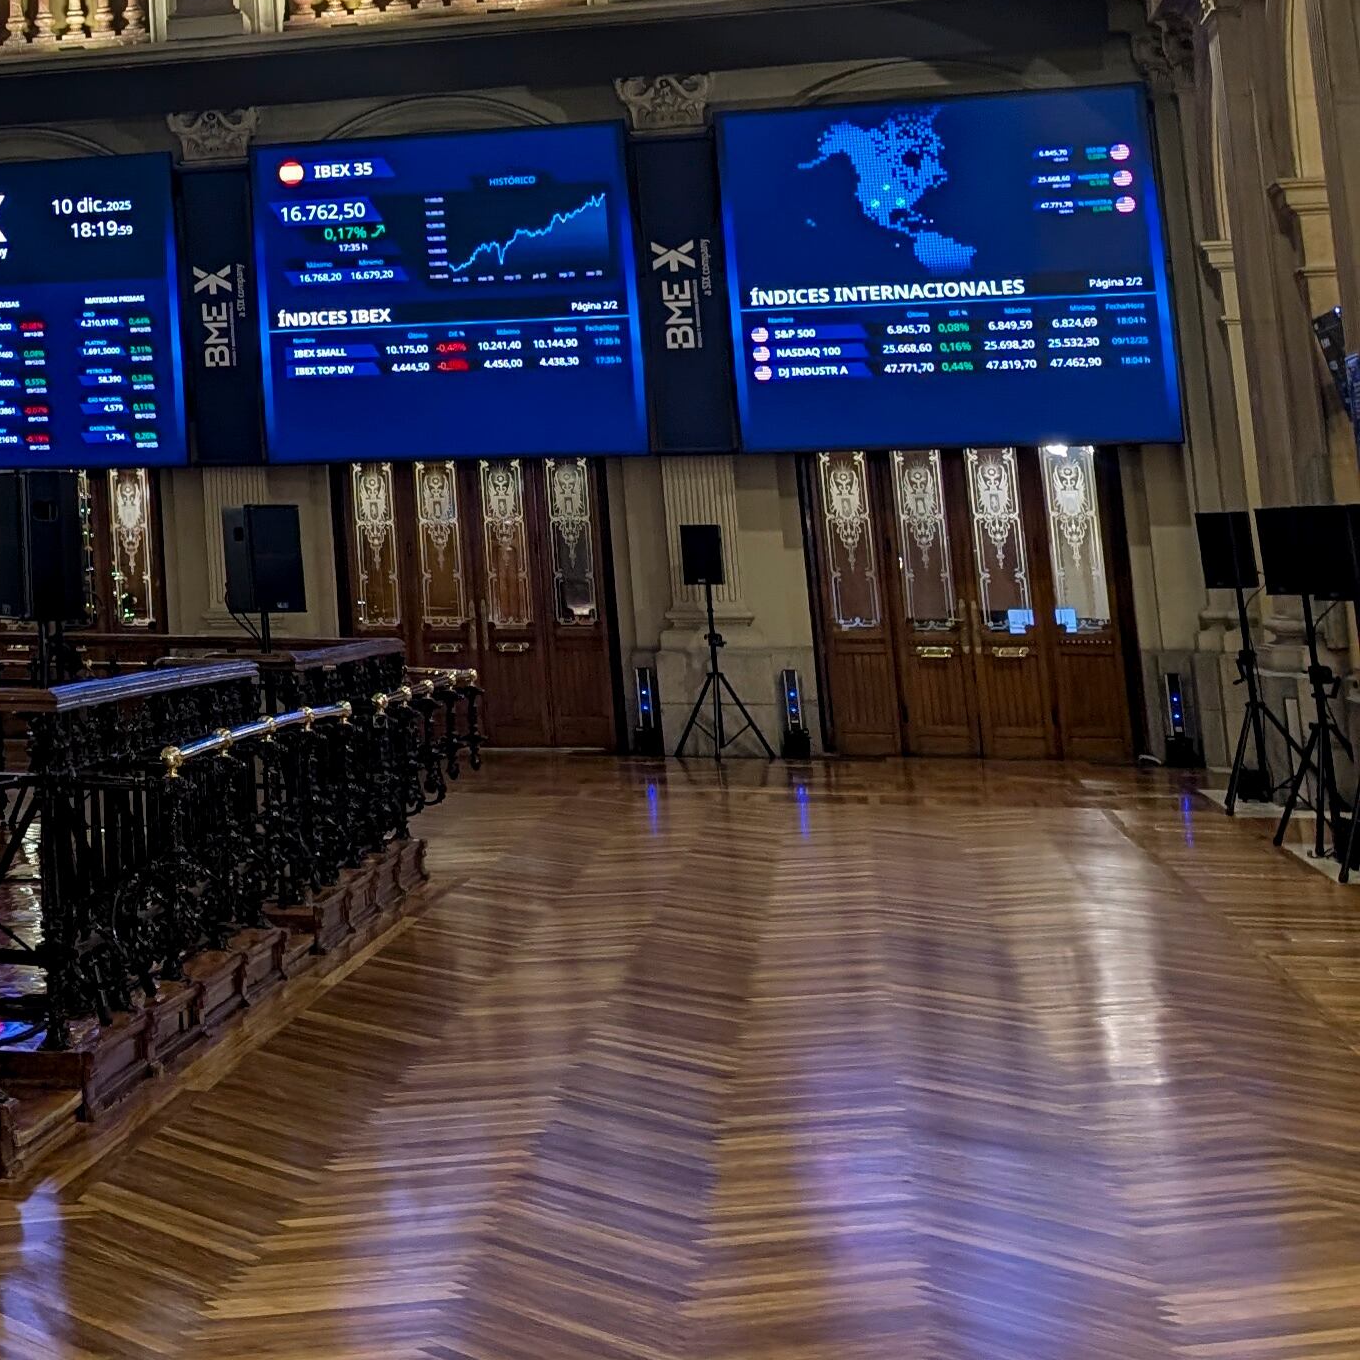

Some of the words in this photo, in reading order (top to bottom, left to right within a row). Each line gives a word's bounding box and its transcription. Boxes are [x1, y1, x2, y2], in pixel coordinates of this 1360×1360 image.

[314, 163, 351, 178] IBEX
[354, 162, 373, 176] 35
[52, 199, 73, 216] 10
[281, 202, 366, 222] 16.762,50
[71, 221, 133, 238] 18:19:59
[324, 226, 367, 242] 0,17%
[339, 244, 360, 252] 17:35
[362, 243, 368, 251] h
[299, 272, 342, 283] 16.768,20
[350, 270, 394, 281] 16.679,20
[750, 287, 830, 306] ÍNDICES
[834, 279, 1026, 302] INTERNACIONALES
[1089, 277, 1124, 289] Página
[1125, 276, 1143, 286] 2/2
[278, 309, 348, 328] ÍNDICES
[351, 308, 392, 324] IBEX
[571, 302, 601, 313] Página
[603, 300, 618, 310] 2/2
[661, 280, 695, 349] BME
[1105, 301, 1146, 310] Fecha/Hora
[201, 302, 231, 368] BME
[774, 330, 796, 339] S&P
[797, 328, 816, 338] 500
[887, 324, 931, 335] 6.845,70
[938, 323, 970, 334] 0,08%
[987, 320, 1033, 331] 6.849,59
[1052, 317, 1098, 329] 6.824,69
[1116, 317, 1139, 325] 18:04
[1140, 316, 1147, 324] h
[294, 348, 314, 359] IBEX
[316, 348, 347, 357] SMALL
[386, 345, 429, 356] 10.175,00
[477, 341, 522, 351] 10.241,40
[533, 339, 579, 349] 10.144,90
[776, 347, 821, 358] NASDAQ
[822, 346, 841, 356] 100
[882, 343, 932, 354] 25.668,60
[939, 342, 972, 353] 0,16%
[984, 340, 1035, 351] 25.698,20
[1047, 337, 1100, 349] 25.532,30
[295, 366, 316, 376] IBEX
[317, 366, 336, 375] TOP
[337, 365, 354, 375] DIV
[391, 363, 430, 373] 4.444,50
[483, 359, 523, 370] 4.456,00
[539, 357, 580, 367] 4.438,30
[778, 367, 790, 377] DJ
[792, 366, 839, 377] INDUSTR
[839, 366, 849, 375] A
[884, 362, 935, 373] 47.771,70
[941, 361, 974, 372] 0,44%
[985, 359, 1038, 370] 47.819,70
[1050, 356, 1102, 369] 47.462,90
[106, 433, 125, 441] 1,794
